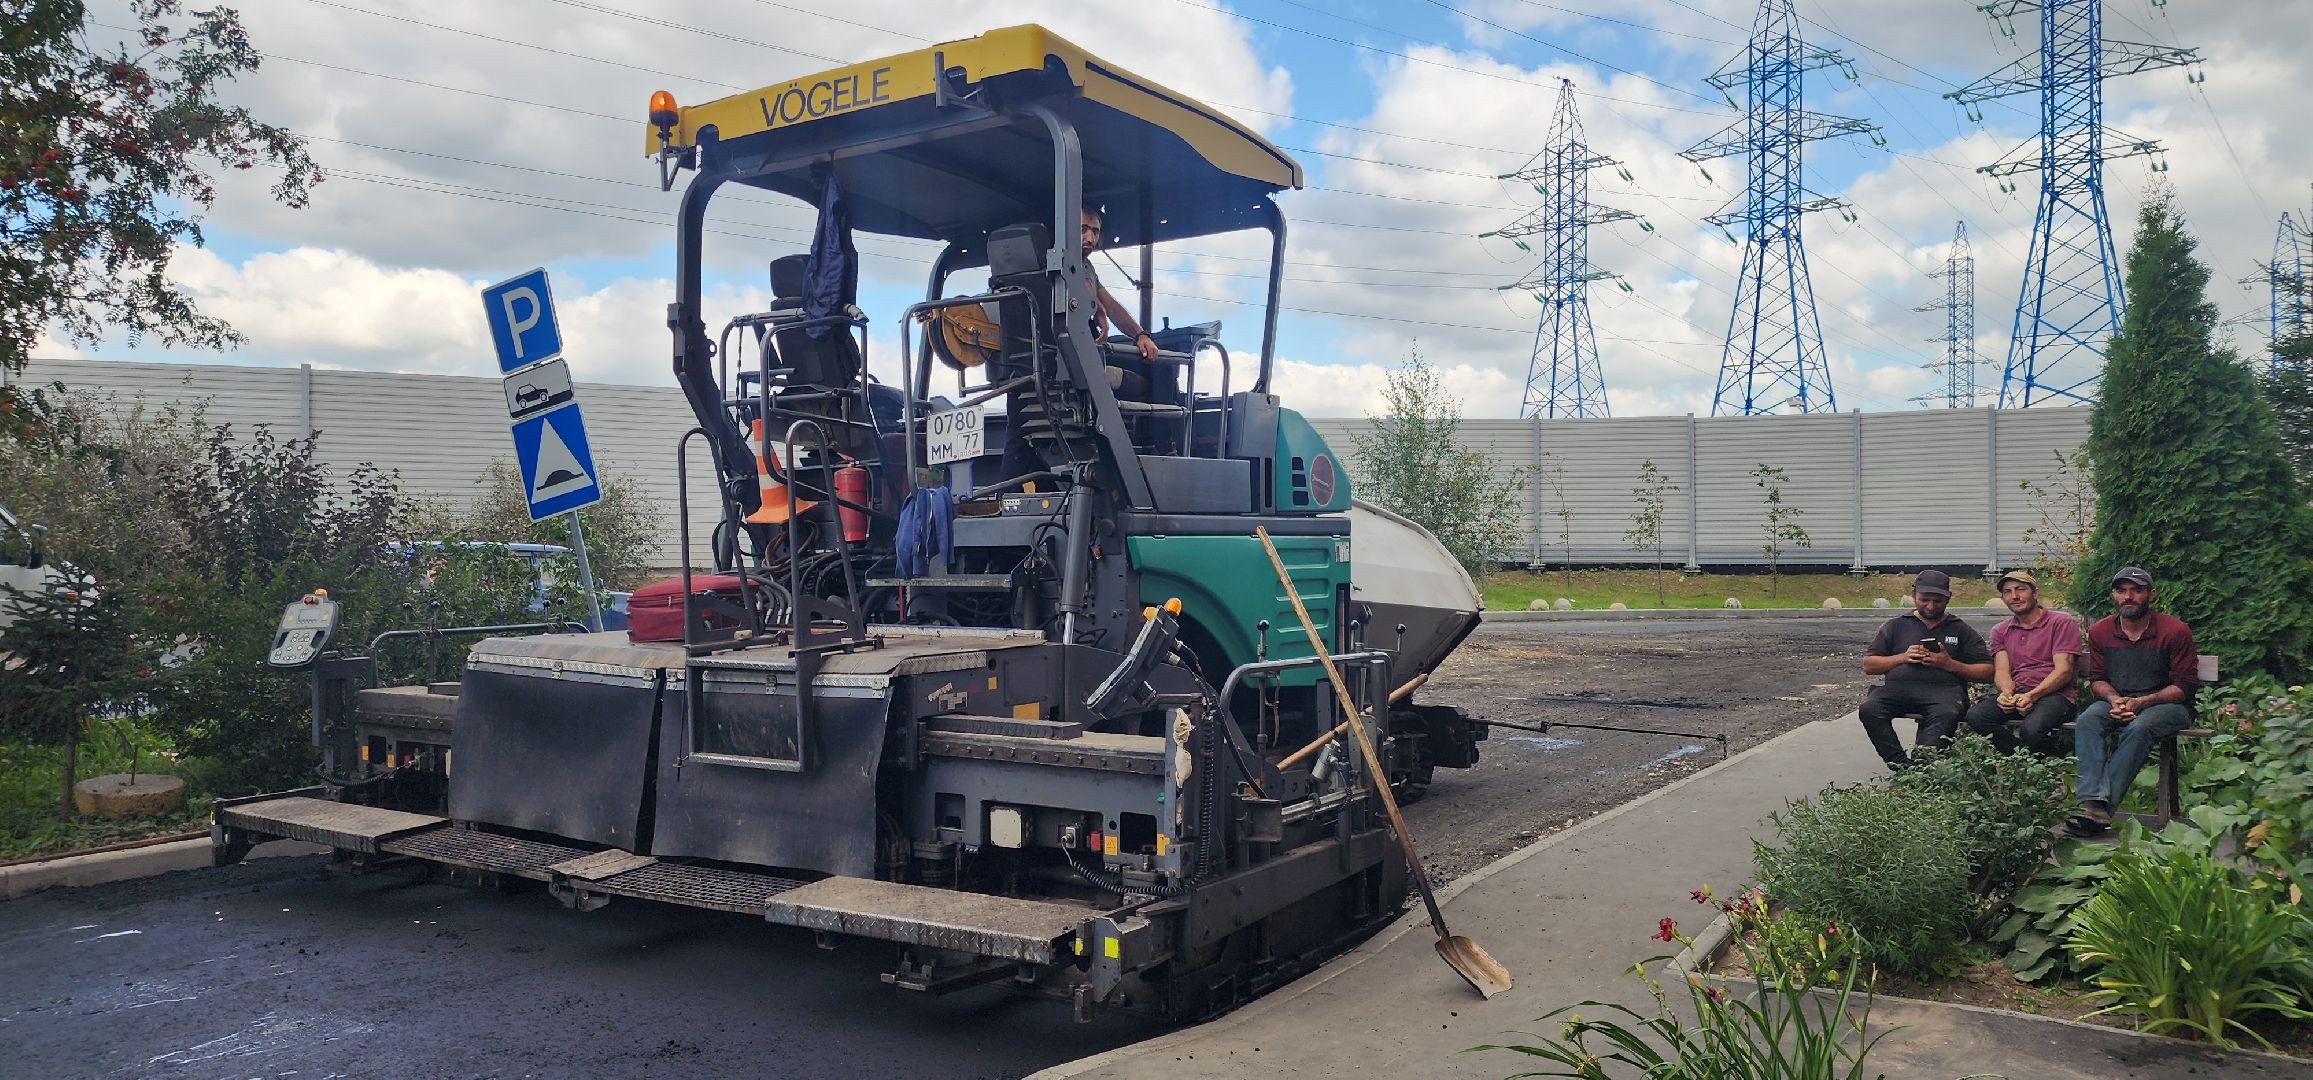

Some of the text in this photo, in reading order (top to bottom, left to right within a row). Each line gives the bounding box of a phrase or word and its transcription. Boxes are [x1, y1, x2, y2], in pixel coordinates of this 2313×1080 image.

[760, 67, 891, 127] VÖGELE
[502, 286, 541, 359] P
[934, 410, 976, 435] 0780
[963, 432, 979, 449] 77
